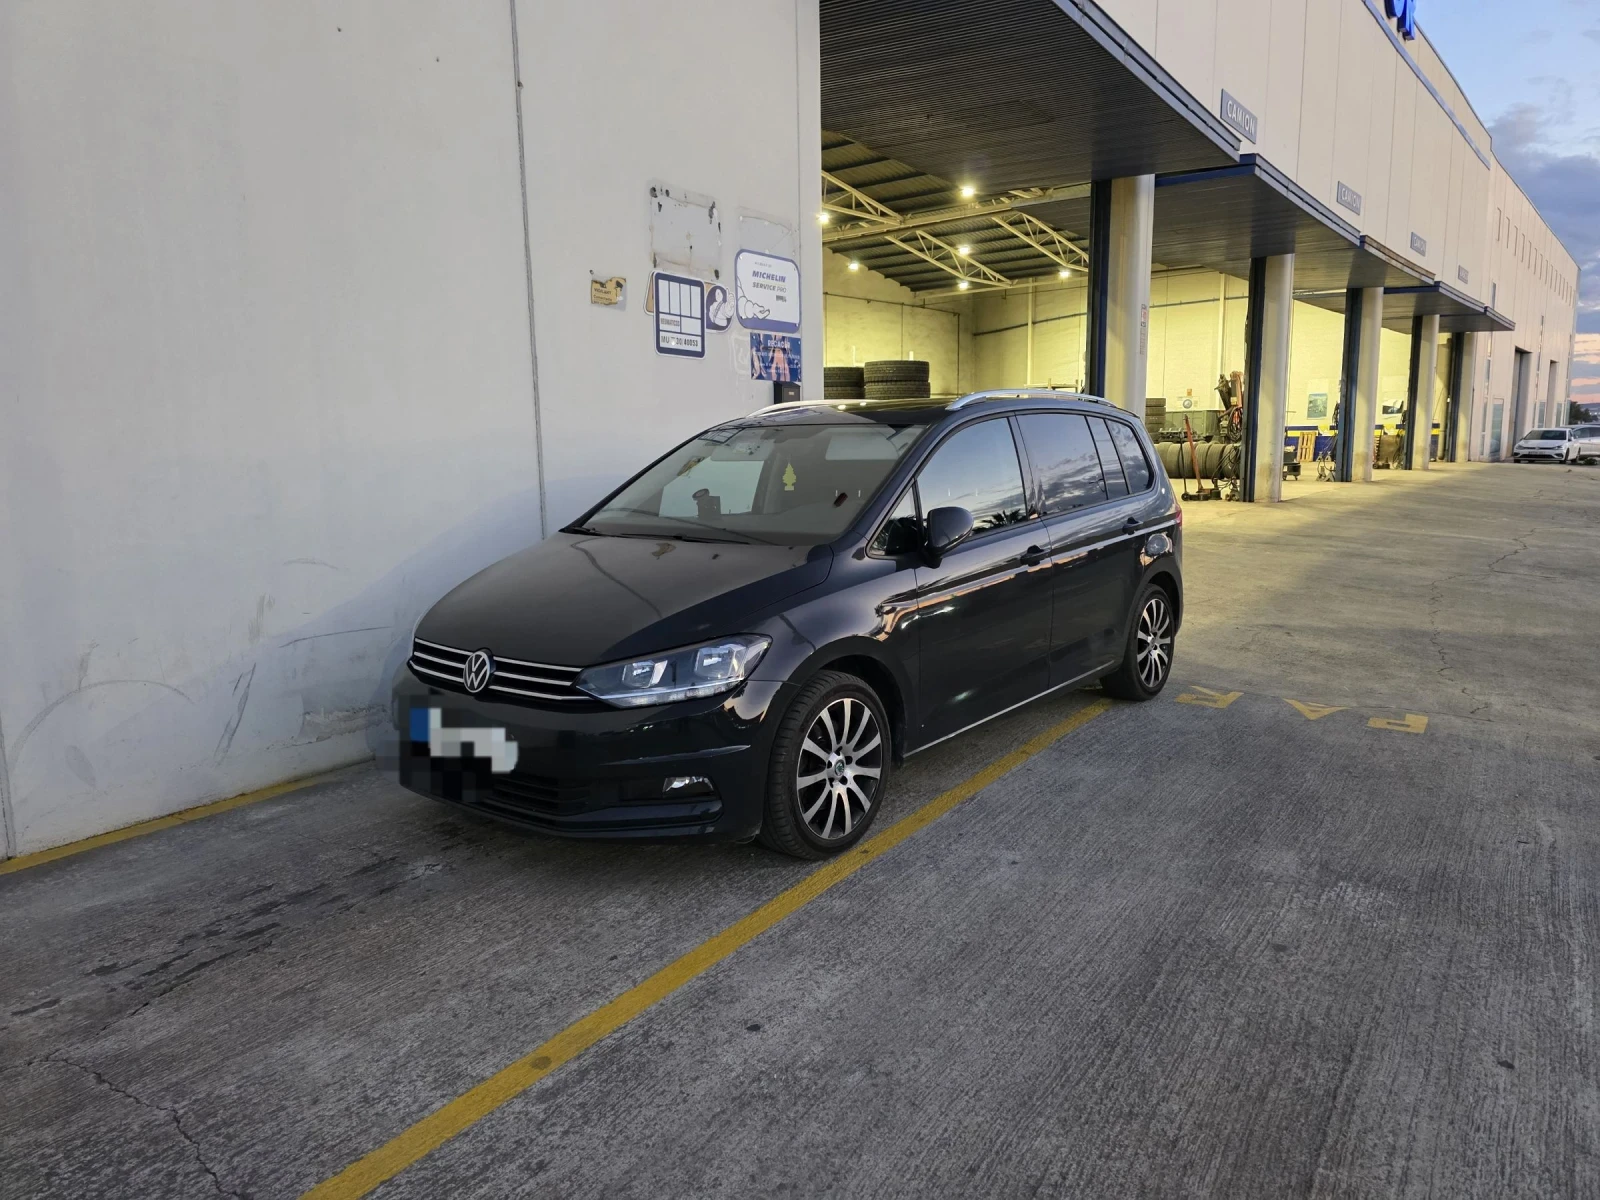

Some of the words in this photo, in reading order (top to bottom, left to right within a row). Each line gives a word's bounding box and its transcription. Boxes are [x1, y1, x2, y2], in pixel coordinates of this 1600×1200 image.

[1227, 100, 1255, 135] CAMION
[752, 270, 786, 283] MICHELIN
[752, 281, 776, 291] SERVICE
